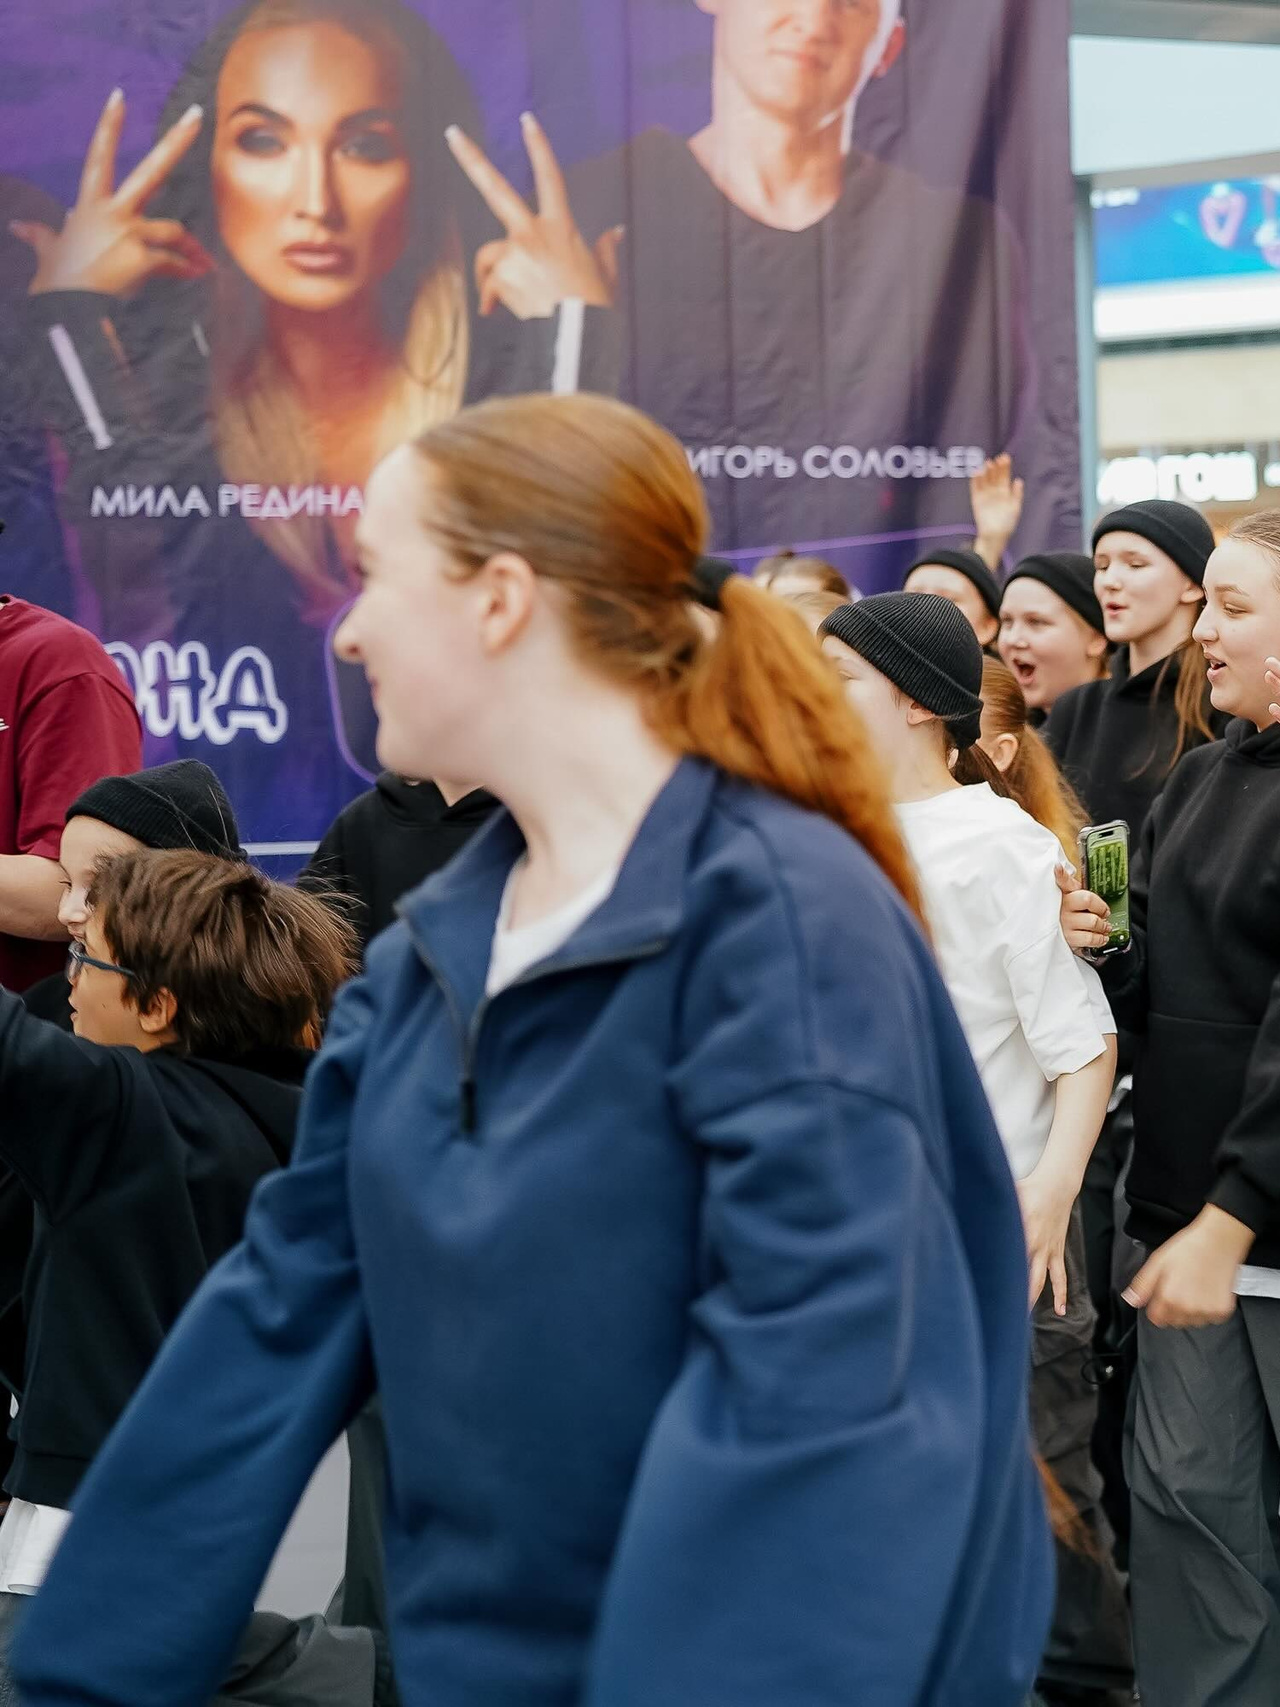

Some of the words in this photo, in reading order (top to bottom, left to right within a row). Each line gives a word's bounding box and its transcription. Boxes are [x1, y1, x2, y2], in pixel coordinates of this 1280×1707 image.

[685, 445, 798, 478] ИГОРЬ
[802, 445, 986, 479] СОЛОВЬЕВ
[91, 484, 211, 518] МИЛА
[217, 484, 365, 519] РЕДИНА
